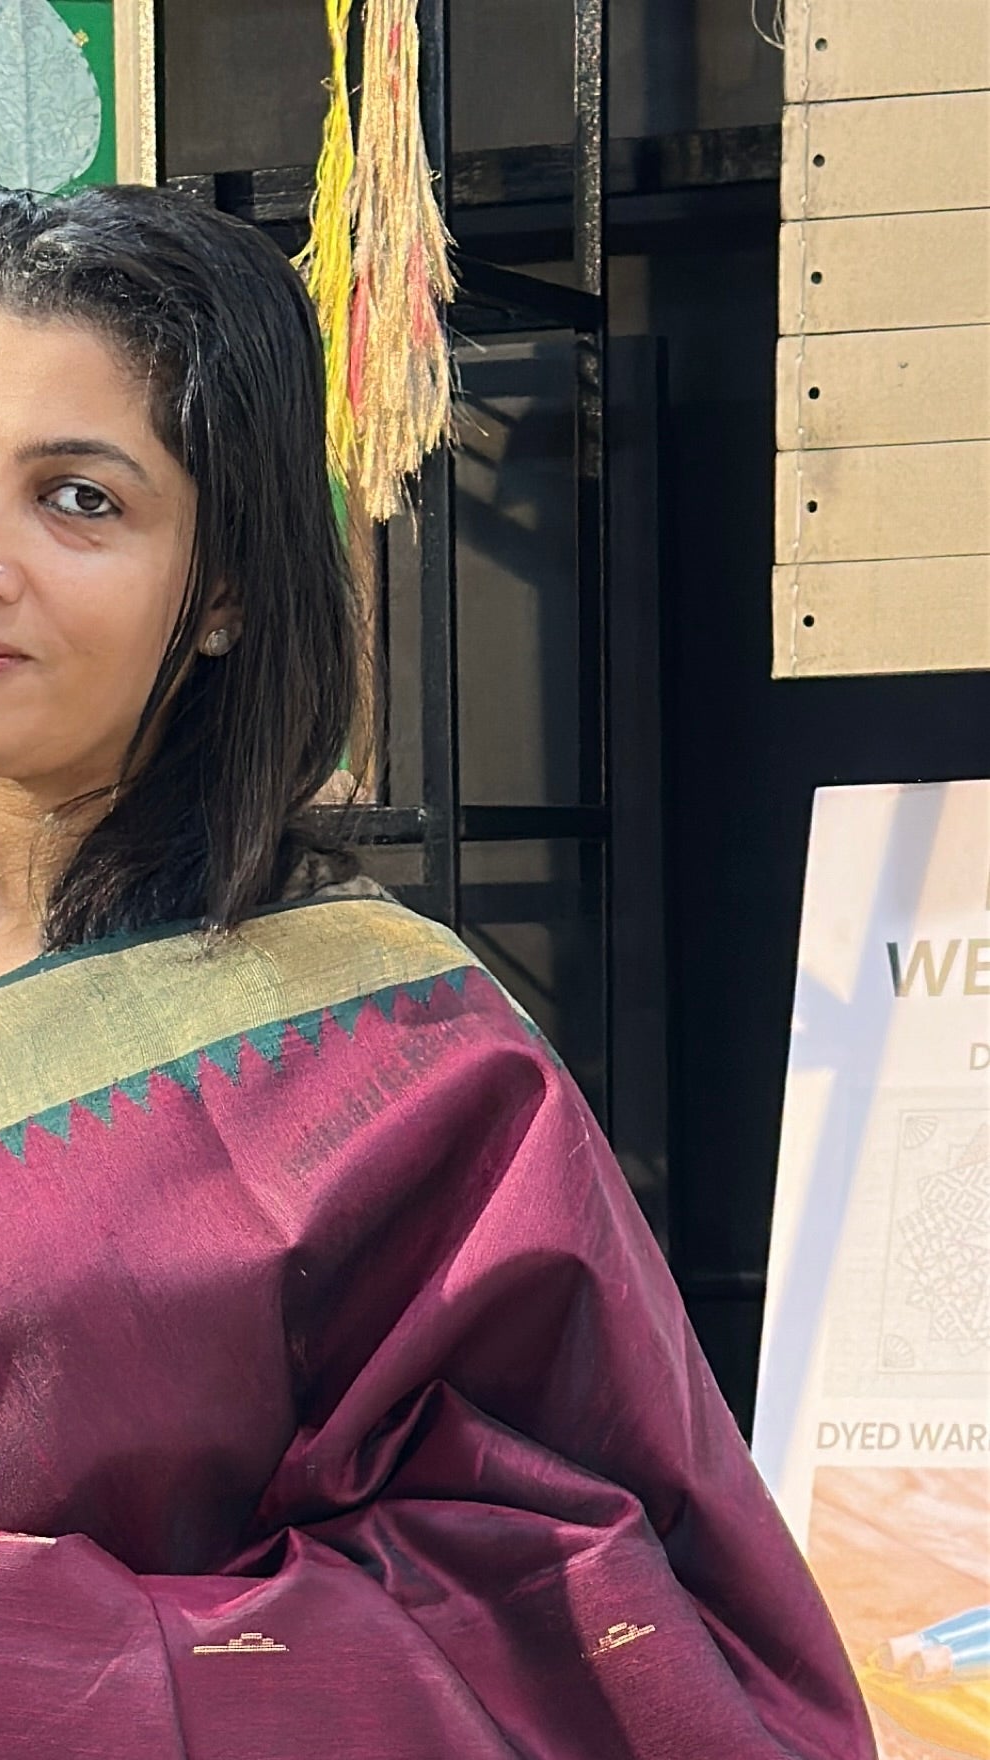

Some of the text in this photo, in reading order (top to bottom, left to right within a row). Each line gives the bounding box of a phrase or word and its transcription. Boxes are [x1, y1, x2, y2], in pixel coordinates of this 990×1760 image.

[886, 938, 990, 998] WE
[816, 1421, 990, 1451] DYED WAR
